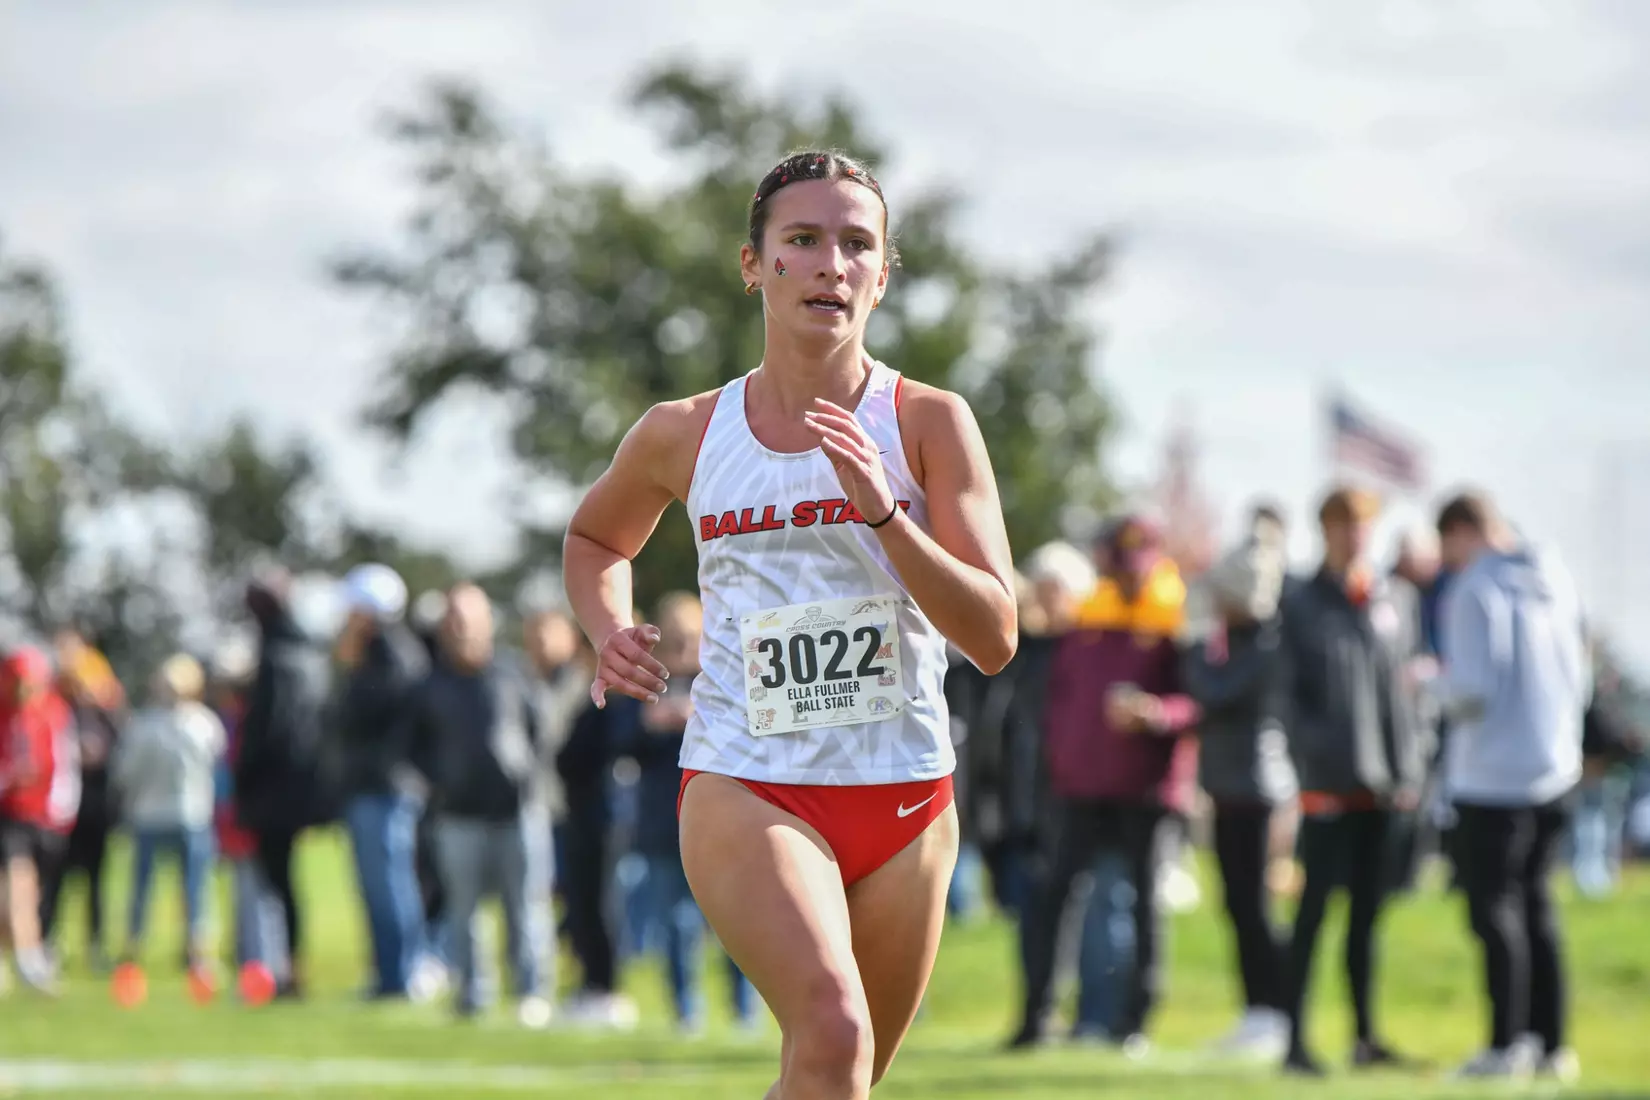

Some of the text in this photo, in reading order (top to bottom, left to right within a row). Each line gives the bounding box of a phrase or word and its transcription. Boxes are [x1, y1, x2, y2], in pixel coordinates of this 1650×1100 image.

[700, 498, 910, 541] BALL STA
[786, 620, 847, 632] CROSS COUNTRY
[758, 626, 885, 689] 3022
[787, 685, 812, 701] ELLA
[815, 681, 861, 697] FULLMER
[796, 695, 856, 713] BALL STATE
